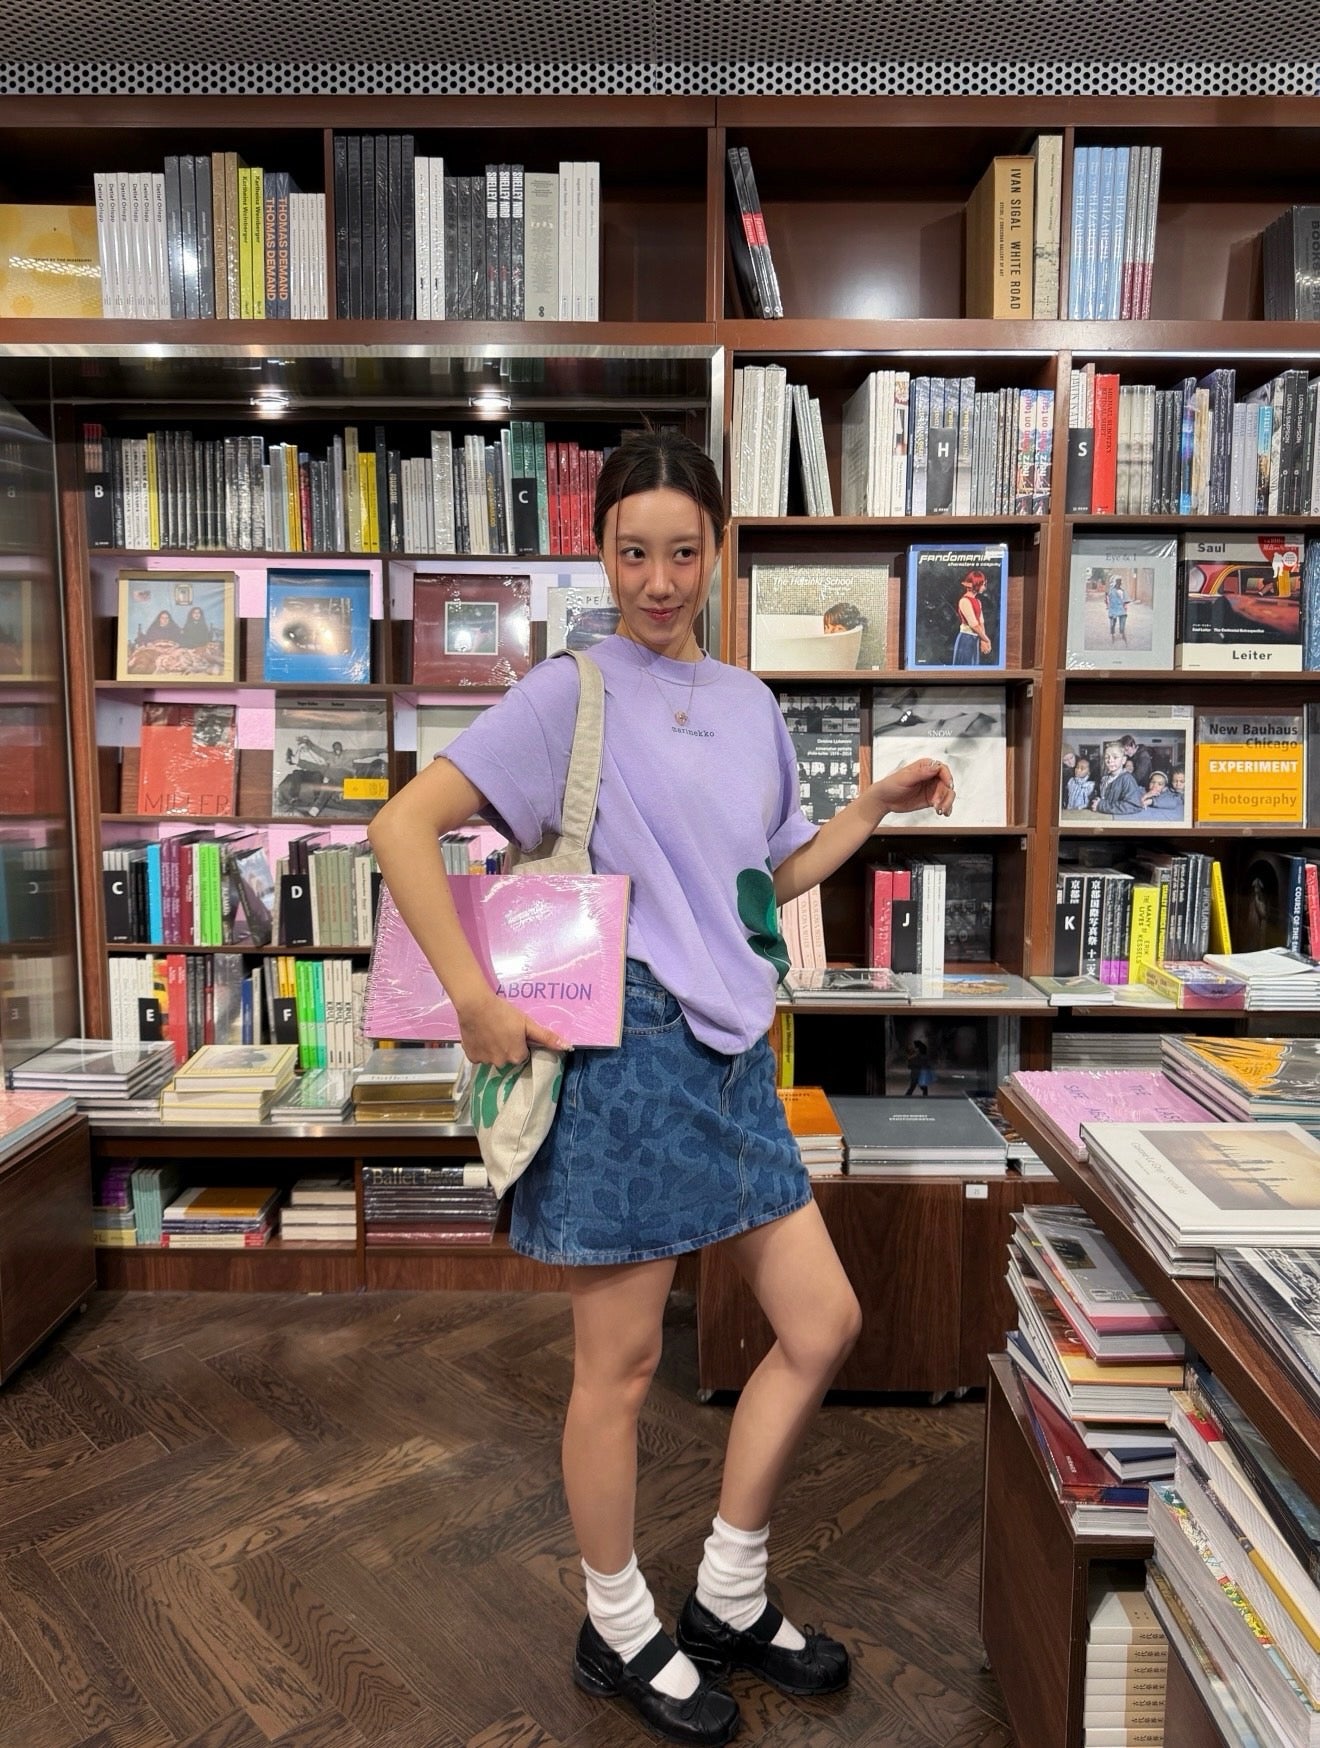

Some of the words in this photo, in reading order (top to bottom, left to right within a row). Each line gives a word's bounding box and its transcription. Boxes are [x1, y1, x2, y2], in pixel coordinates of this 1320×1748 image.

[487, 172, 497, 200] SHELLEY
[500, 172, 510, 200] SHELLEY
[512, 172, 523, 200] SHELLEY
[1010, 168, 1021, 193] IVAN
[266, 197, 275, 248] THOMAS
[279, 197, 288, 248] THOMAS
[1010, 199, 1021, 231] SIGAL
[1010, 241, 1021, 275] WHITE
[266, 250, 275, 301] DEMAND
[279, 250, 288, 301] DEMAND
[1010, 281, 1021, 310] ROAD
[1284, 416, 1292, 444] SIMPSON
[937, 442, 948, 457] H
[1078, 442, 1088, 457] S
[94, 485, 104, 498] B
[390, 473, 398, 504] FOURSOME
[518, 490, 529, 504] C
[1197, 542, 1226, 552] Saul
[824, 576, 854, 586] School
[1232, 650, 1272, 660] Leiter
[1209, 724, 1238, 735] New
[1243, 724, 1298, 735] Bauhaus
[1246, 738, 1298, 752] Chicago
[1209, 760, 1298, 773] EXPERIMENT
[1212, 793, 1296, 807] Photography
[112, 882, 124, 895] C
[291, 886, 302, 898] D
[1294, 886, 1302, 914] COURSE
[1201, 888, 1210, 930] UPHOLLAND
[902, 912, 910, 926] J
[1064, 916, 1076, 930] K
[1294, 916, 1300, 925] OF
[495, 982, 592, 1000] ABORTION
[146, 1008, 155, 1022] E
[282, 1008, 292, 1022] F
[336, 1002, 344, 1025] KRULL
[344, 1002, 352, 1025] KRULL
[372, 1168, 419, 1185] Ballet
